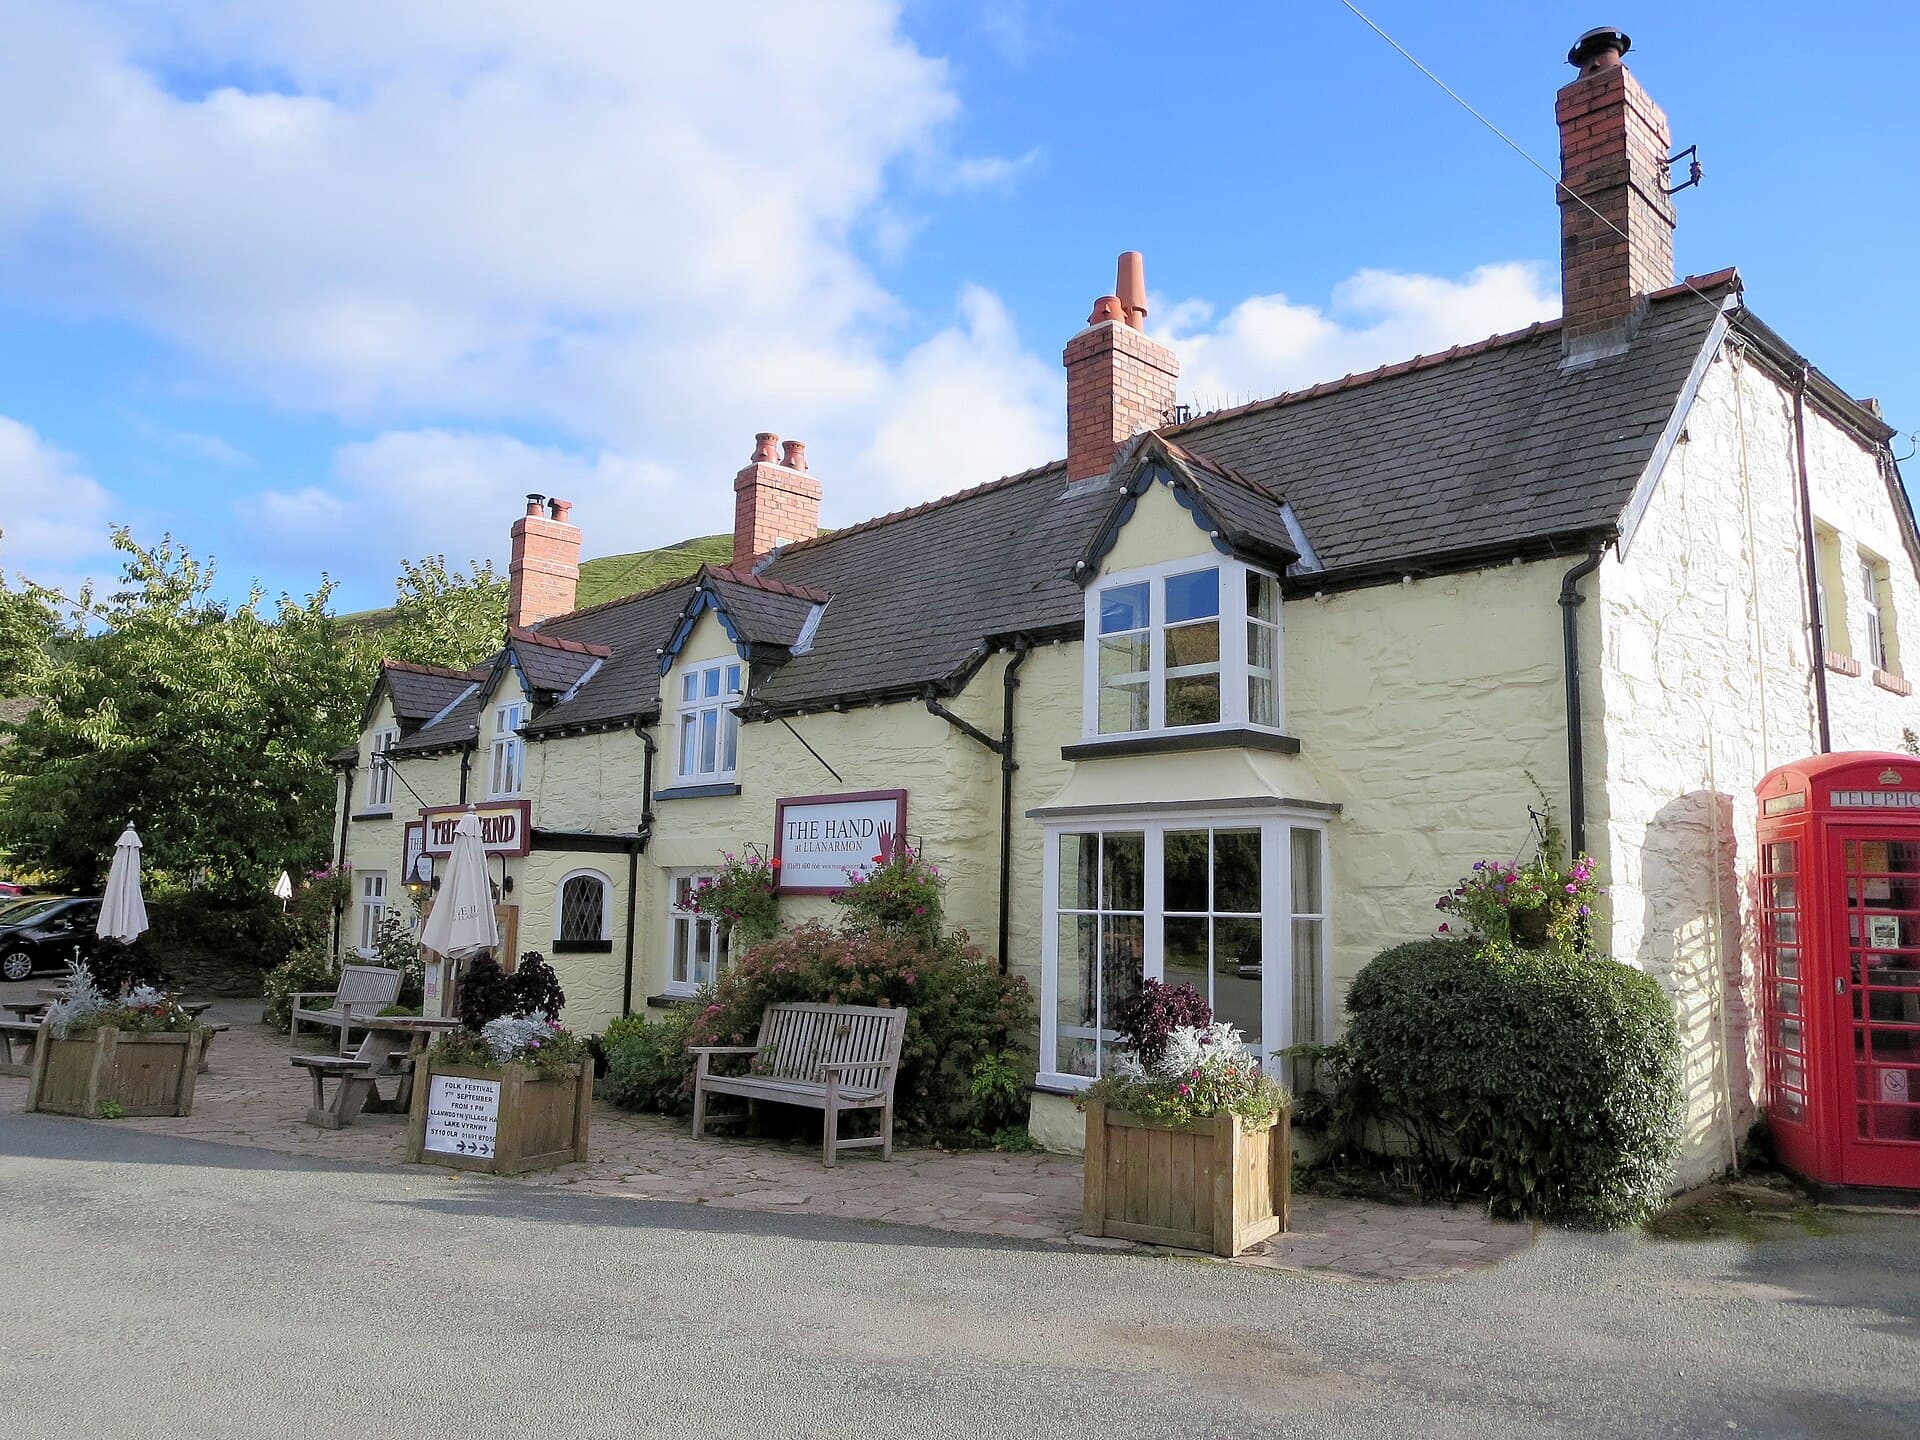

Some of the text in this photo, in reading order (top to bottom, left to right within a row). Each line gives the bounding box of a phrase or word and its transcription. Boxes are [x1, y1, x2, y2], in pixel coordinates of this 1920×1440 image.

[479, 815, 516, 843] AND
[787, 818, 874, 840] THE HAND
[794, 840, 863, 853] at LLANARMON
[464, 1083, 494, 1093] FESTIVAL
[457, 1093, 493, 1103] SEPTEMBER
[451, 1102, 468, 1110] FROM
[464, 1112, 488, 1122] VILLAGE
[444, 1120, 488, 1131] LAKE VYRNWY
[431, 1128, 446, 1136] SY10
